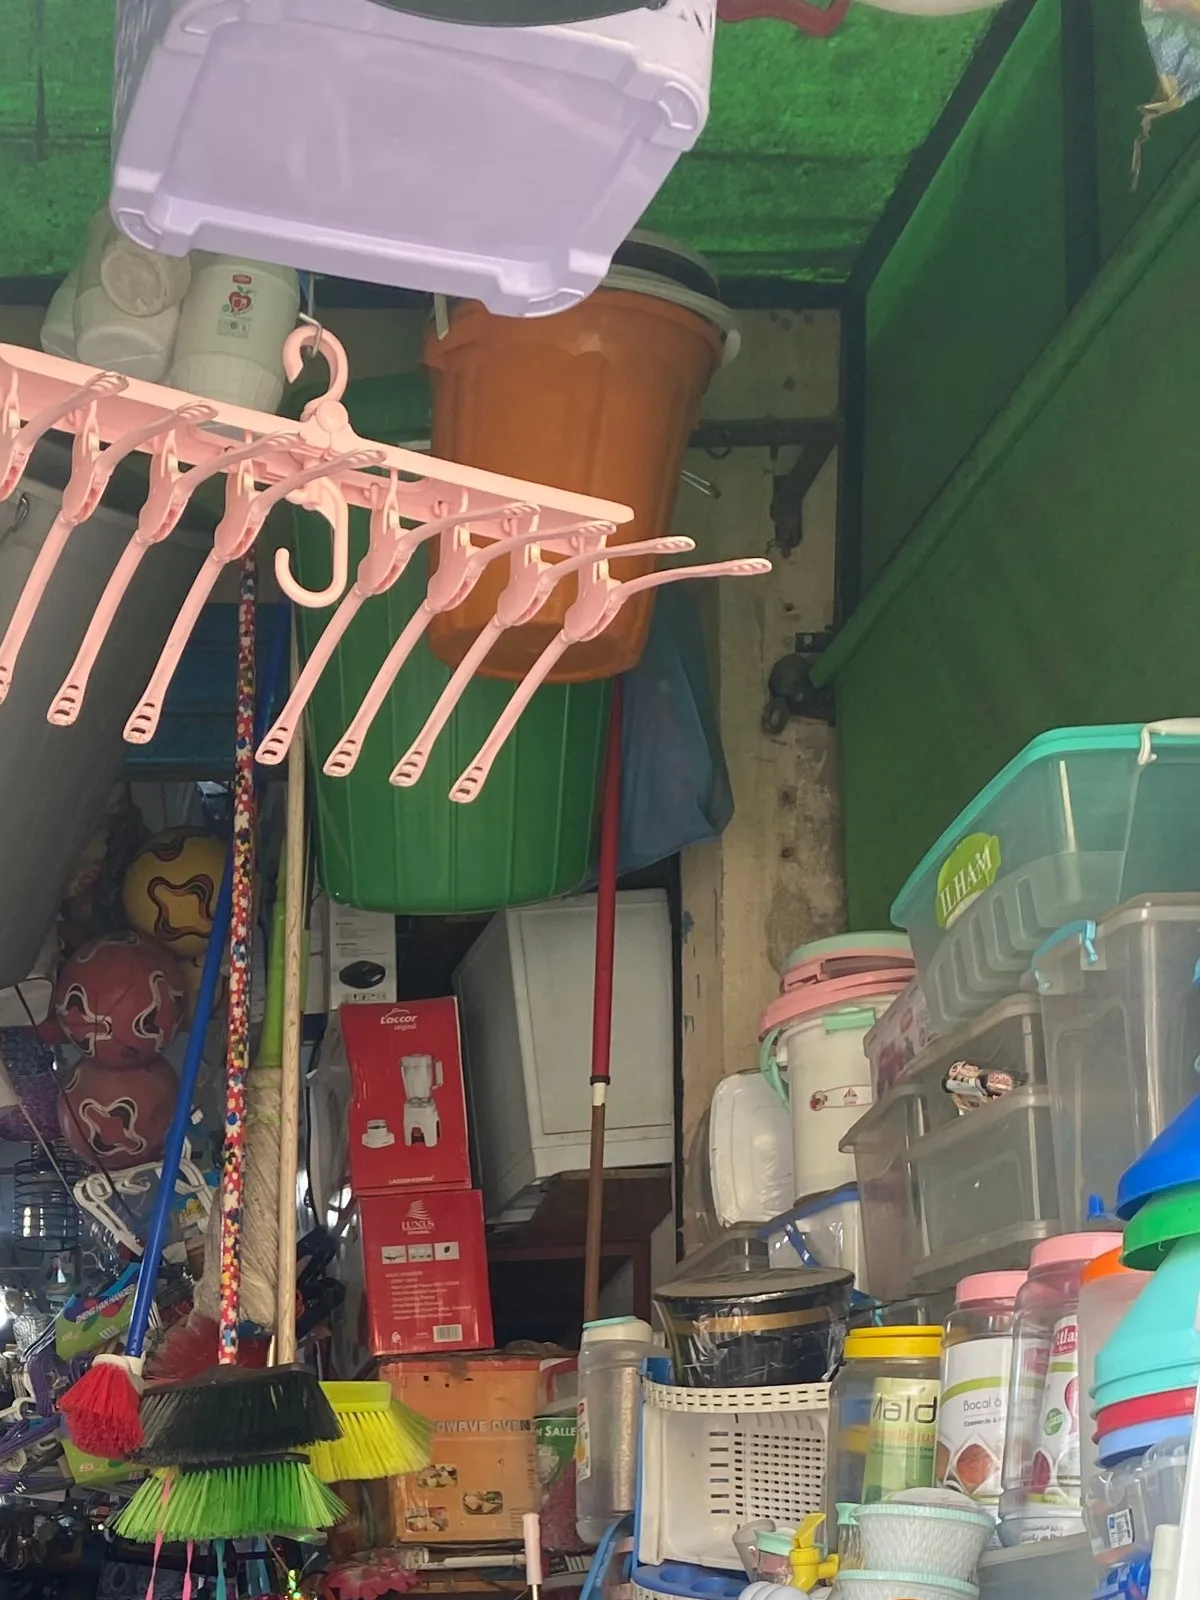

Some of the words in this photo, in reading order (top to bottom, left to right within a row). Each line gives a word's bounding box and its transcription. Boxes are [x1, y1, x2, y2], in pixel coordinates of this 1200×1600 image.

[940, 842, 992, 918] ILHAM
[963, 1396, 991, 1412] Bocal
[490, 1419, 531, 1431] OVEN
